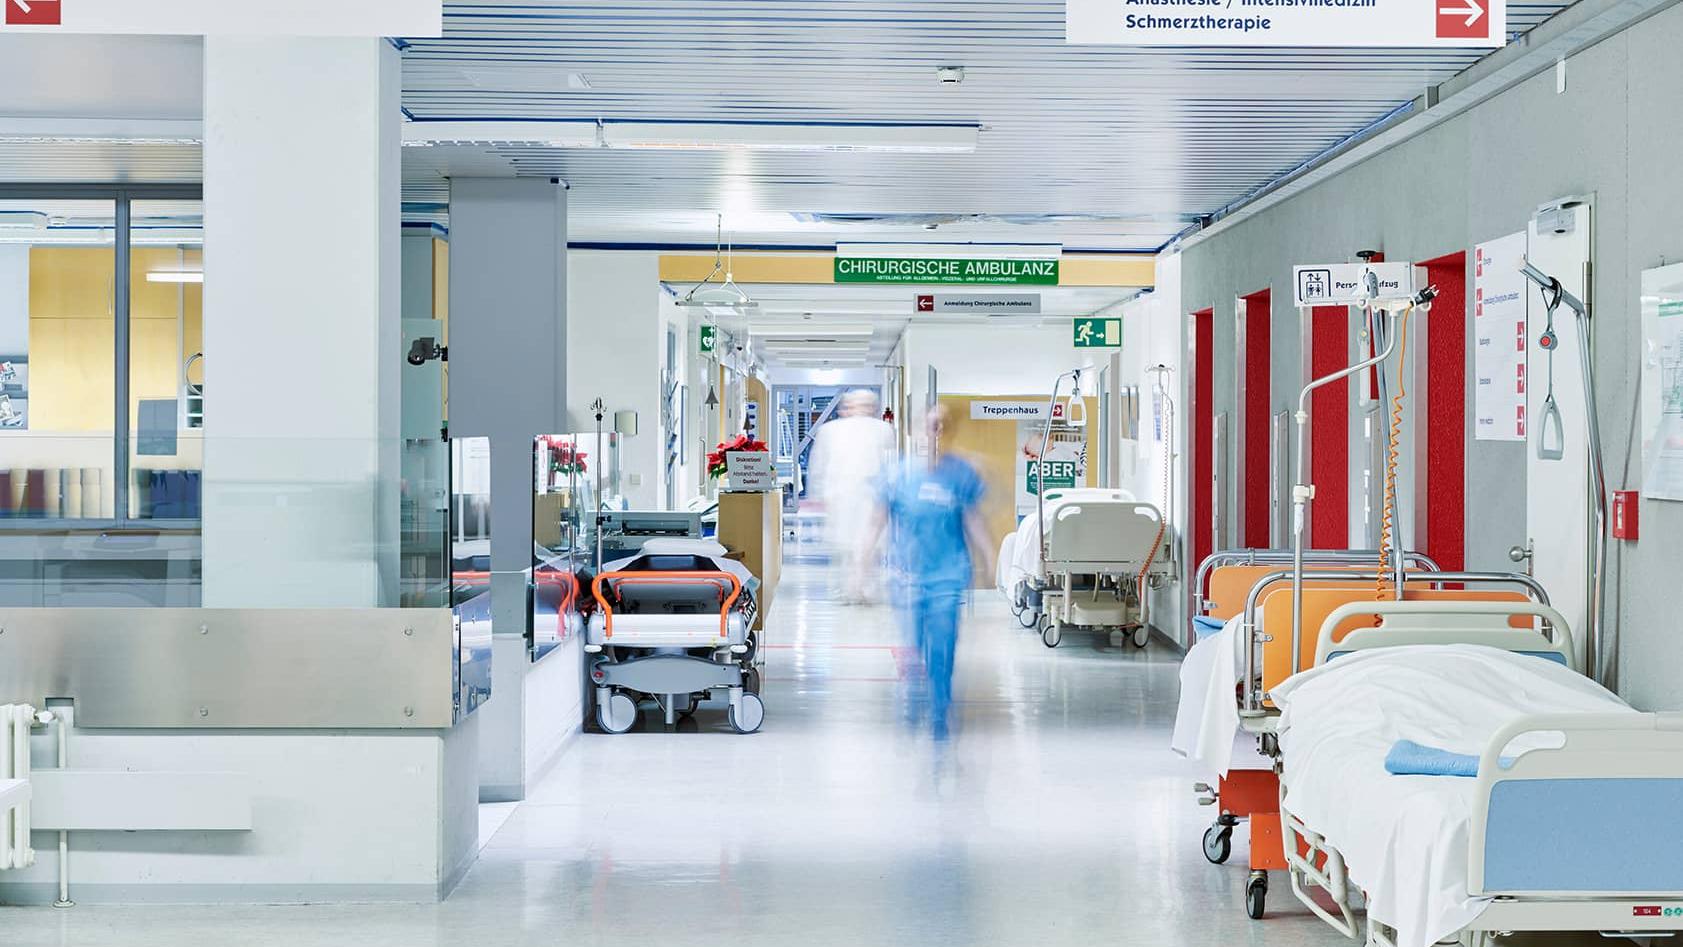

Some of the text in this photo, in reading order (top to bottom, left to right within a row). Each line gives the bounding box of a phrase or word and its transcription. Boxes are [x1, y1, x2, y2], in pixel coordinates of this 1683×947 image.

[1126, 14, 1271, 32] Schmerztherapie
[839, 260, 1055, 275] CHIRURGISCHE AMBULANZ
[983, 406, 1039, 415] Treppenhaus
[1028, 462, 1074, 477] ABER
